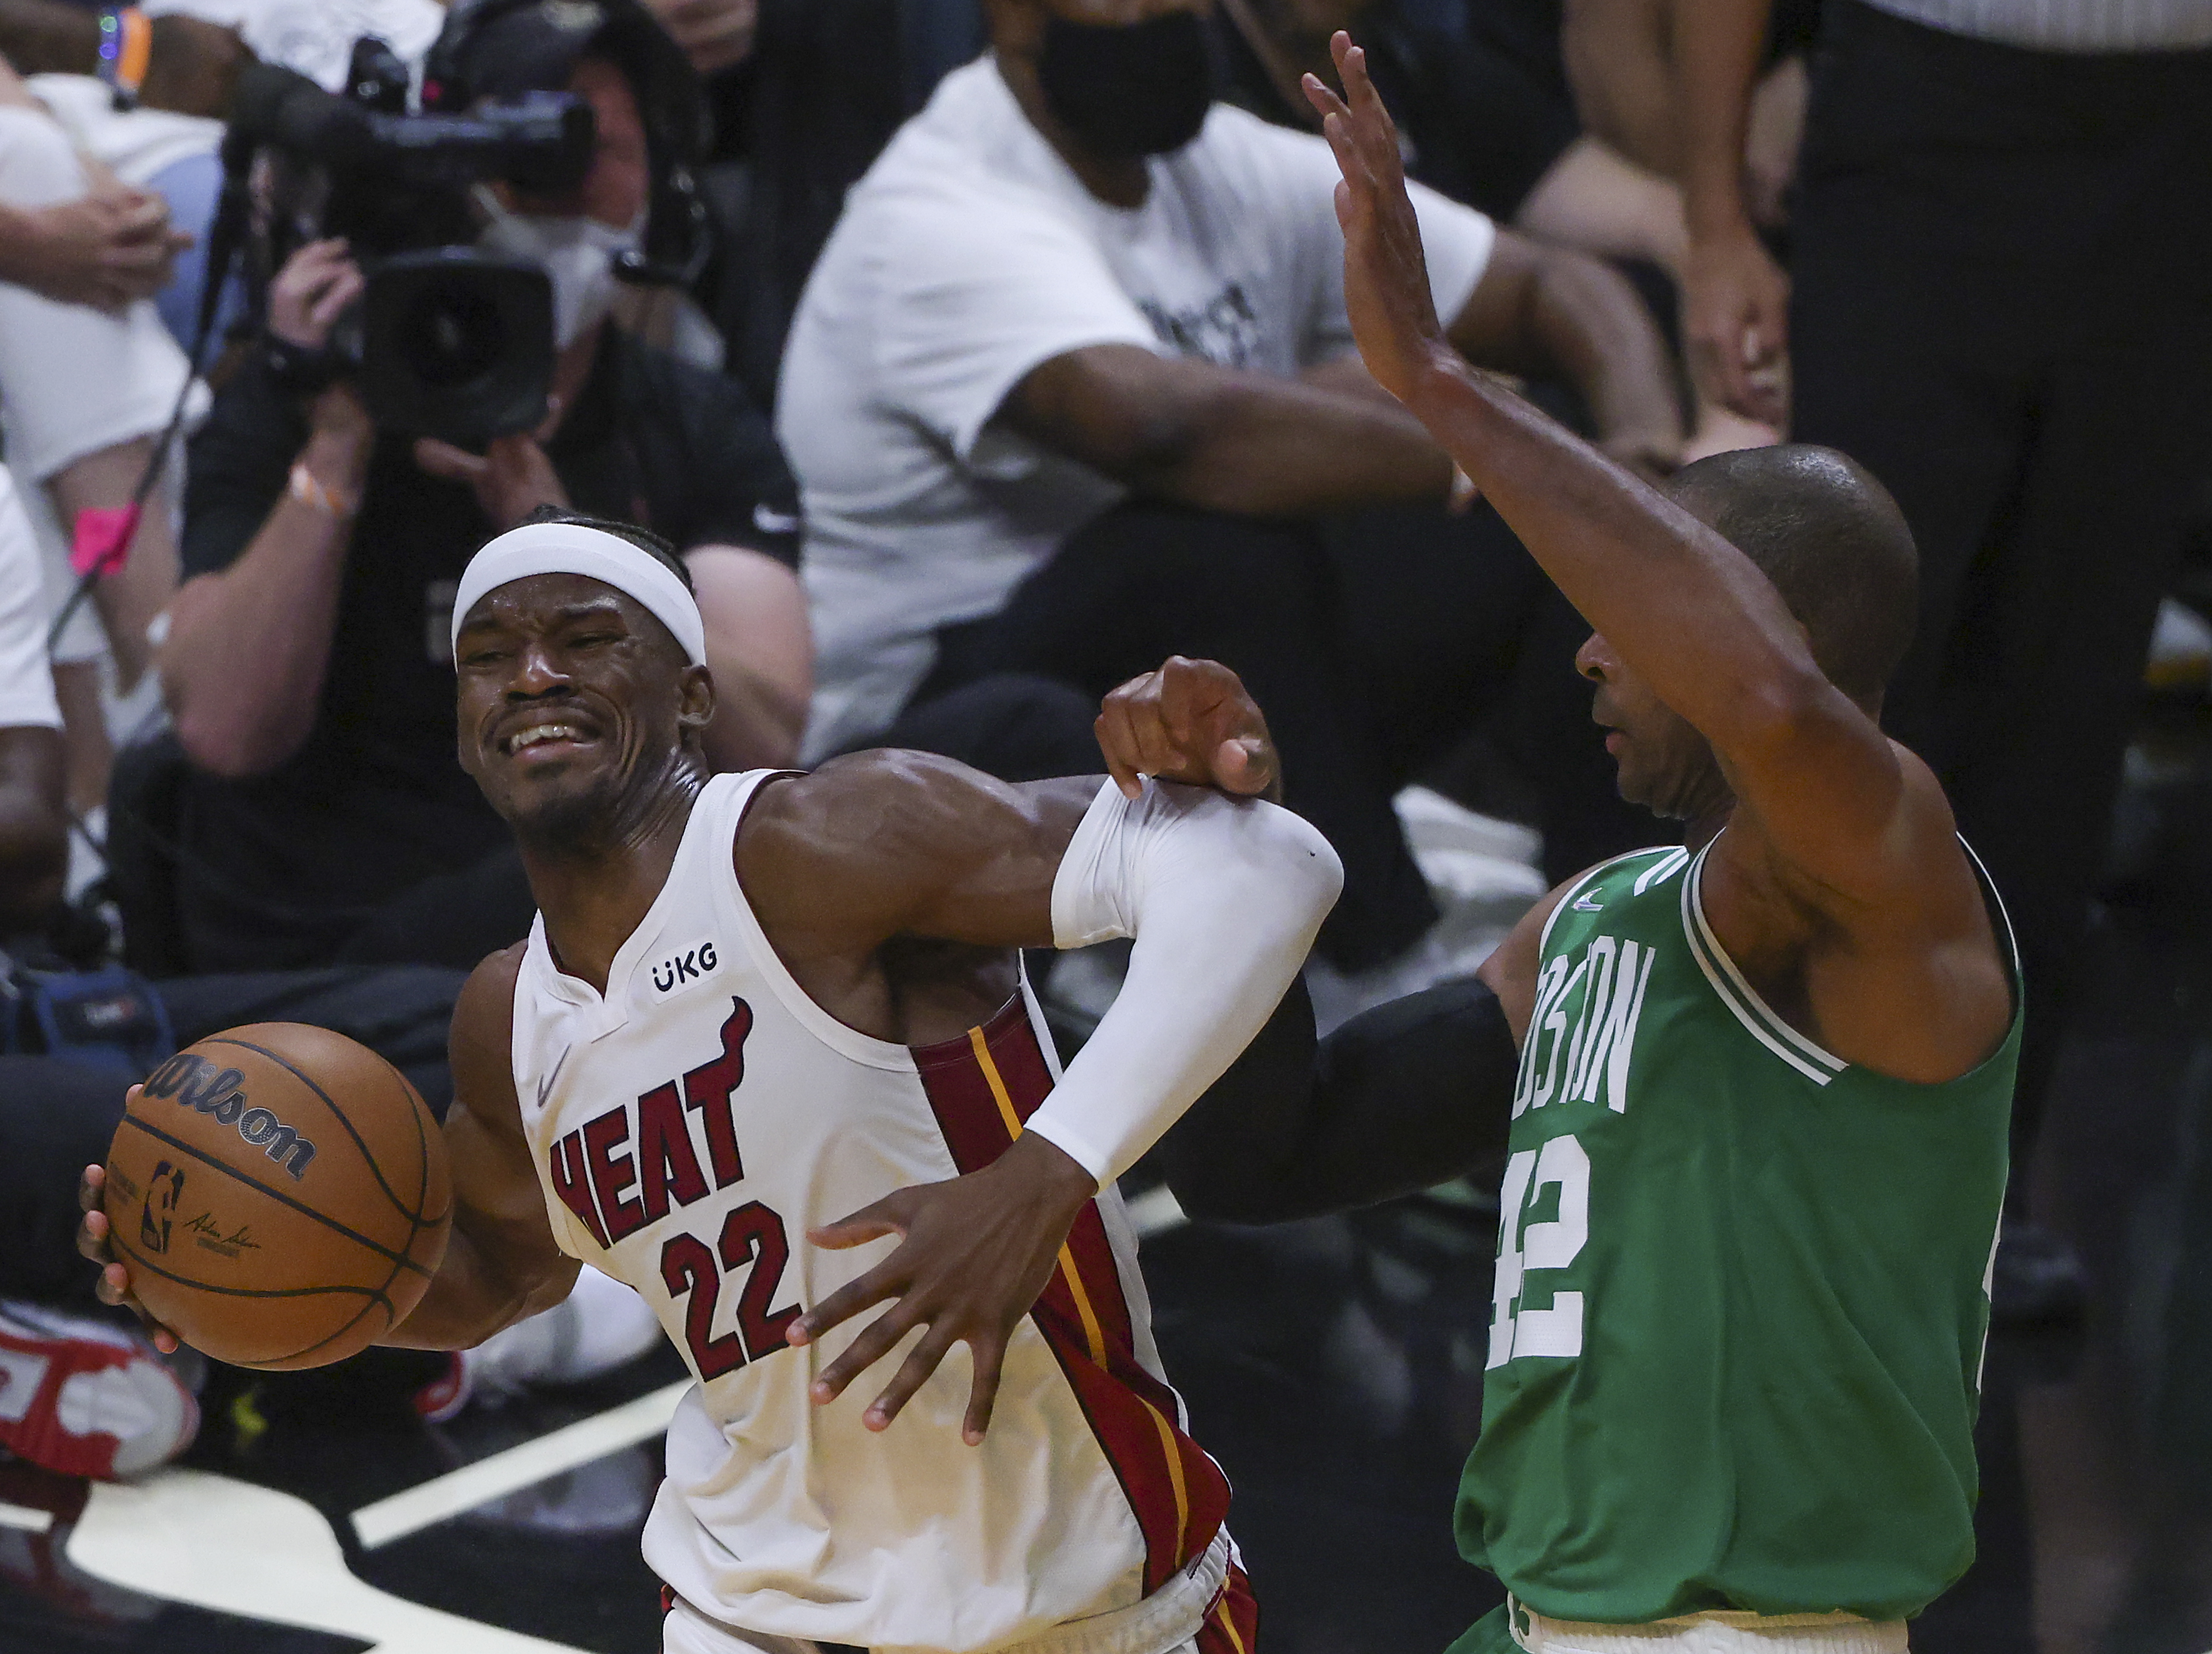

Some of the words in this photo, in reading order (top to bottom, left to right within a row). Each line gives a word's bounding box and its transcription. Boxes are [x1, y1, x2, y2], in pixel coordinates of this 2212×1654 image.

[143, 1053, 317, 1181] Wilson
[549, 996, 754, 1250] HEAT
[660, 1200, 803, 1383] 22
[1484, 1134, 1591, 1371] 42
